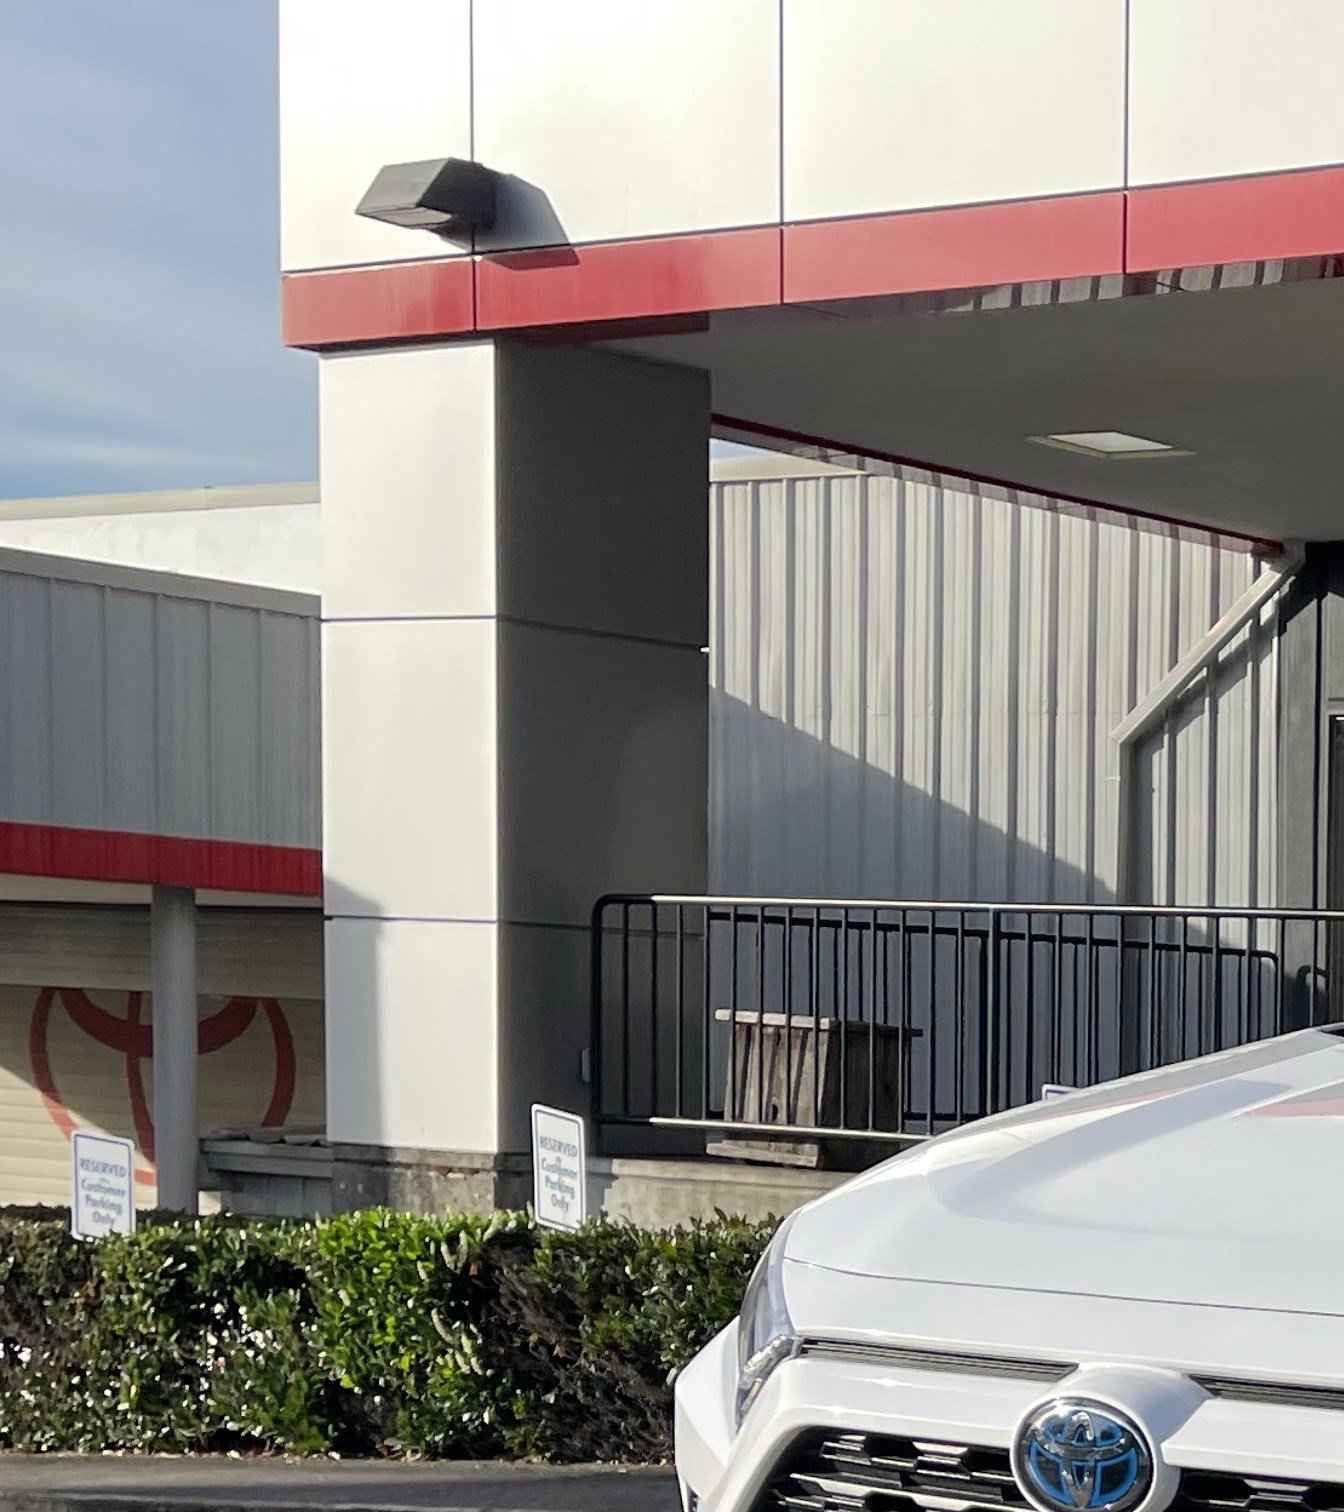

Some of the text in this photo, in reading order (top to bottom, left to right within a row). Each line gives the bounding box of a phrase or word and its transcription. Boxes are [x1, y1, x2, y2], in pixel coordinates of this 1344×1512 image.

[540, 1136, 578, 1158] RESERVED
[80, 1158, 127, 1178] RESERVED
[541, 1158, 578, 1179] Customer
[81, 1178, 126, 1197] Customer
[544, 1174, 575, 1201] Parking
[85, 1194, 122, 1216] Parking
[551, 1193, 569, 1213] Only
